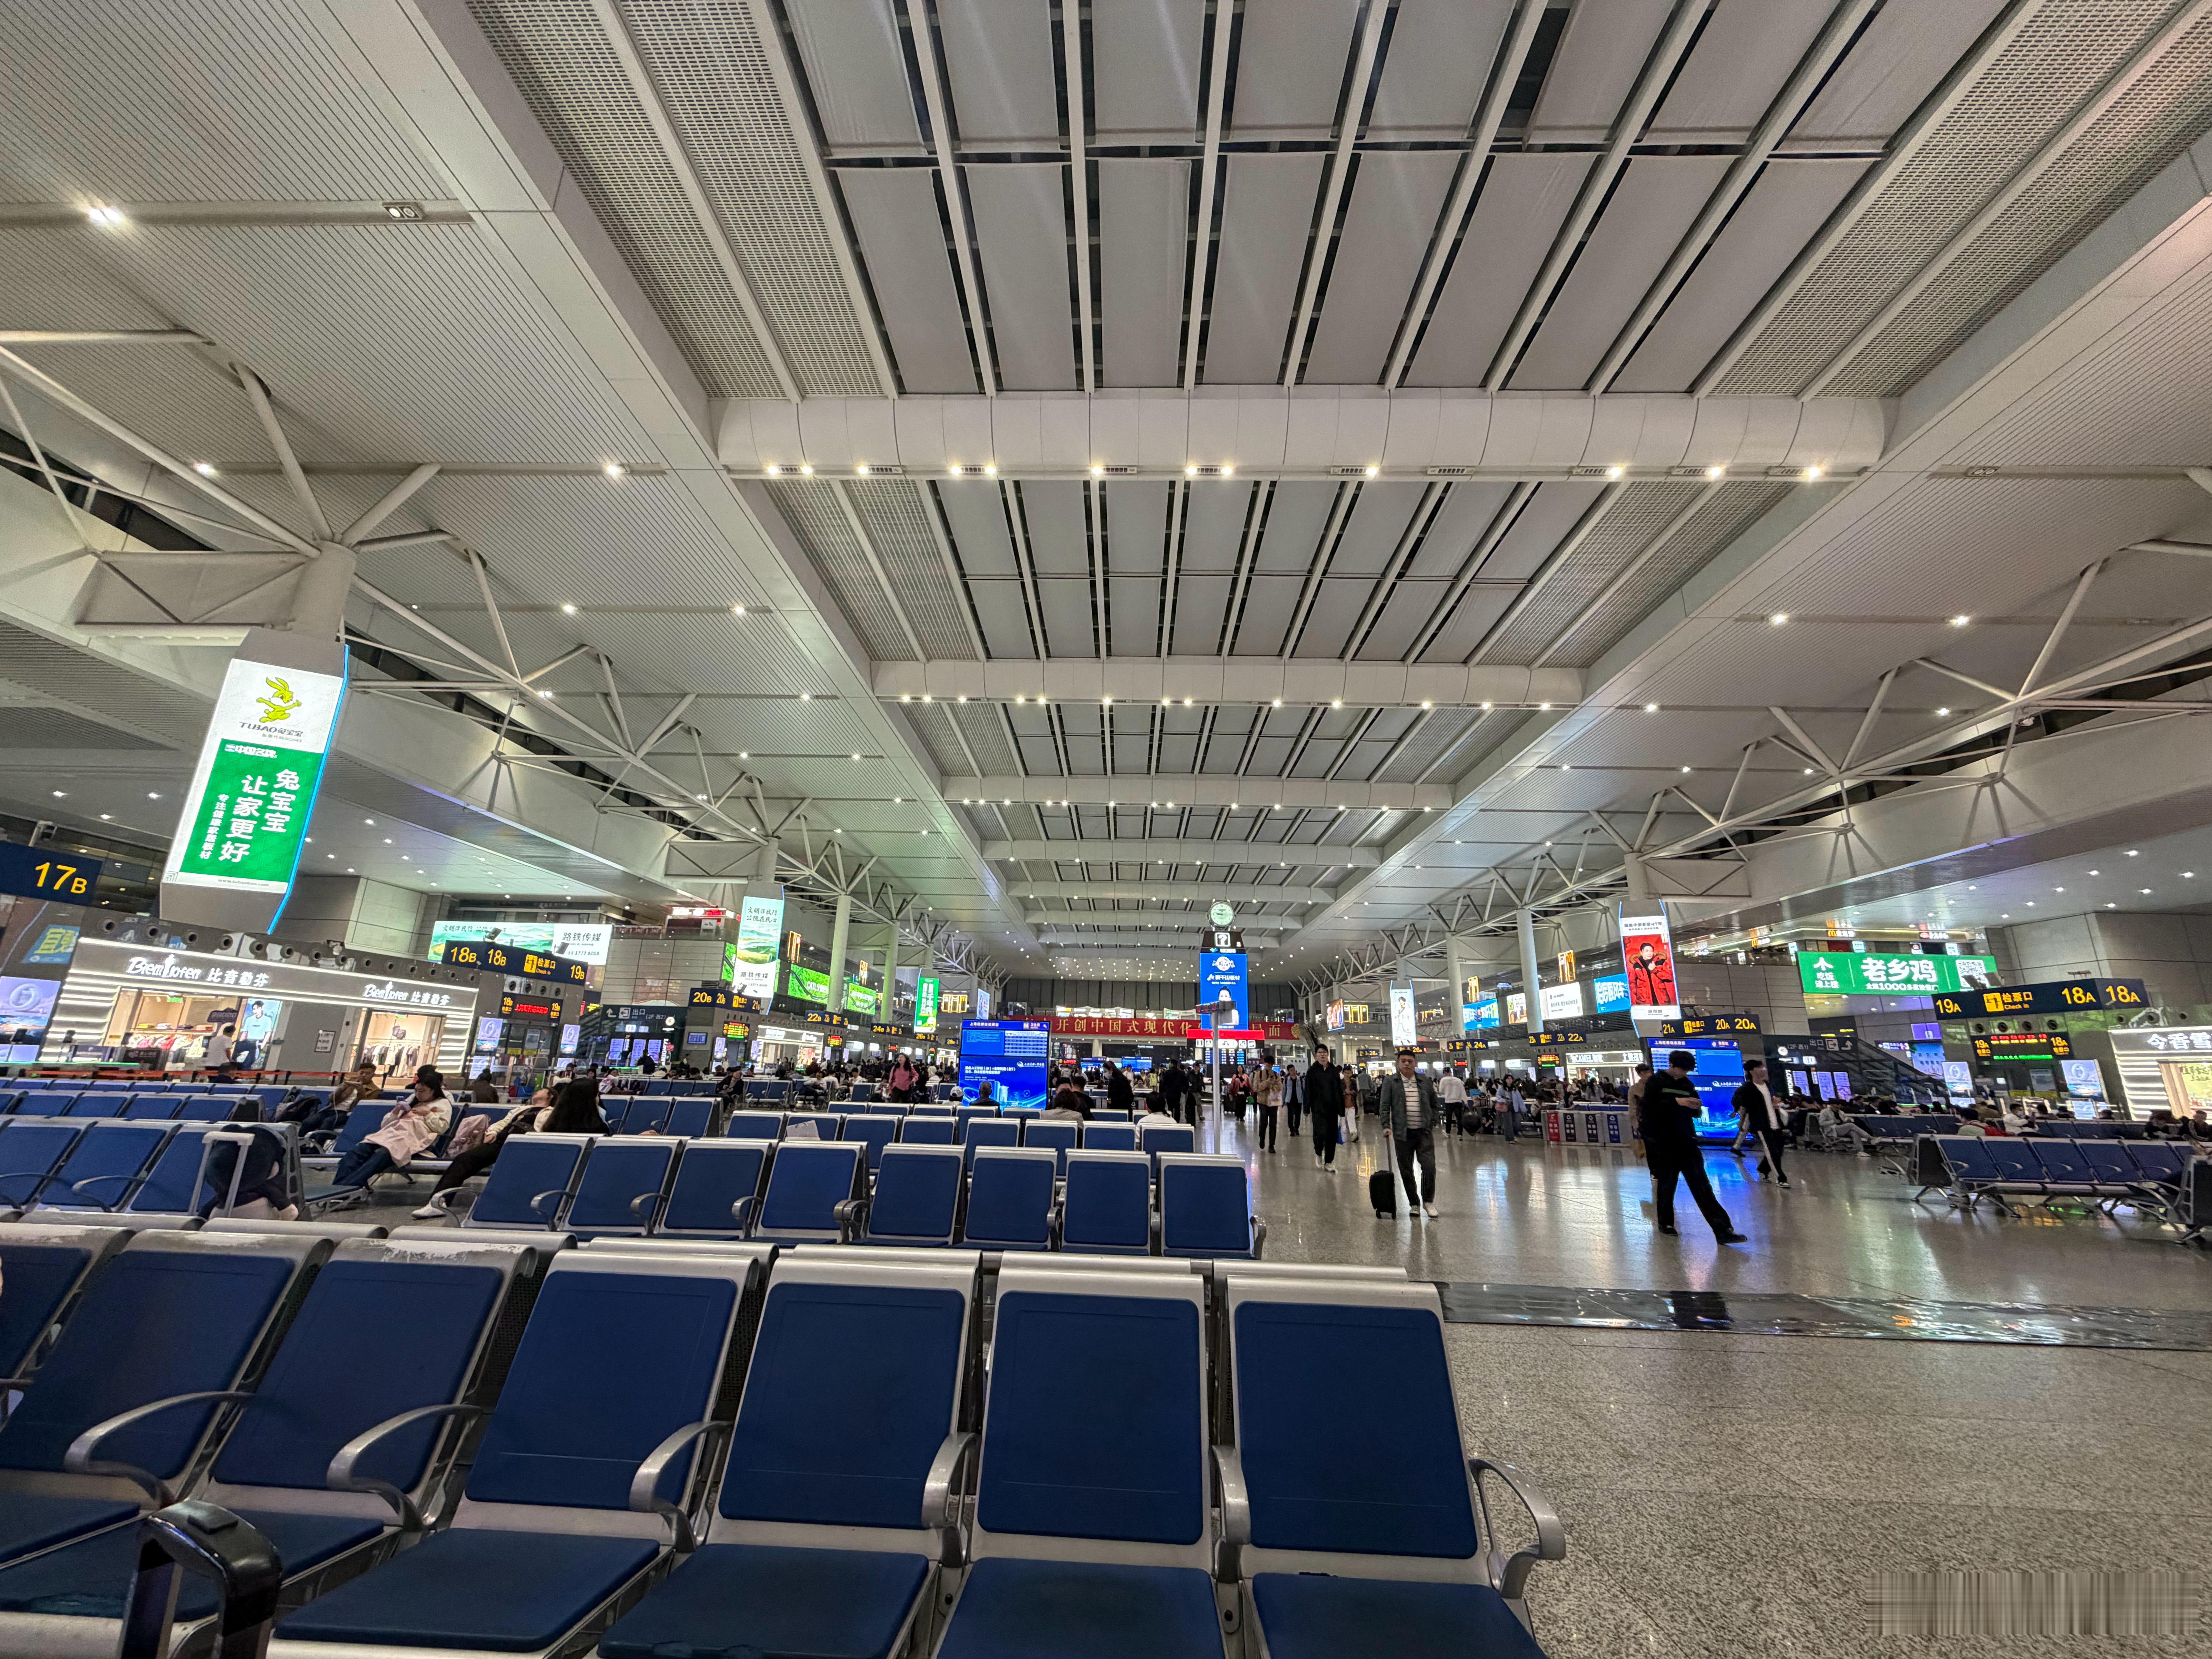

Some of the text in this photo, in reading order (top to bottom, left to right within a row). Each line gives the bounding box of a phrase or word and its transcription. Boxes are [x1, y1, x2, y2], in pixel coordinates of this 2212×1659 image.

[261, 769, 300, 833] 兔宝宝
[218, 775, 268, 862] 让家更好
[35, 862, 87, 894] 17B
[562, 932, 602, 942] 路铁传媒
[450, 947, 477, 963] 18B
[488, 949, 585, 980] 18B 检票口 19B
[206, 967, 269, 988] 比音勒芬
[1861, 957, 1937, 982] 老乡鸡
[693, 992, 712, 1003] 20B
[1936, 987, 2096, 1013] 19A 检票口 18A
[2106, 986, 2141, 1003] 18A
[1716, 1019, 1730, 1030] 20A
[1735, 1018, 1757, 1030] 20A
[2147, 1032, 2212, 1049] 今香雪
